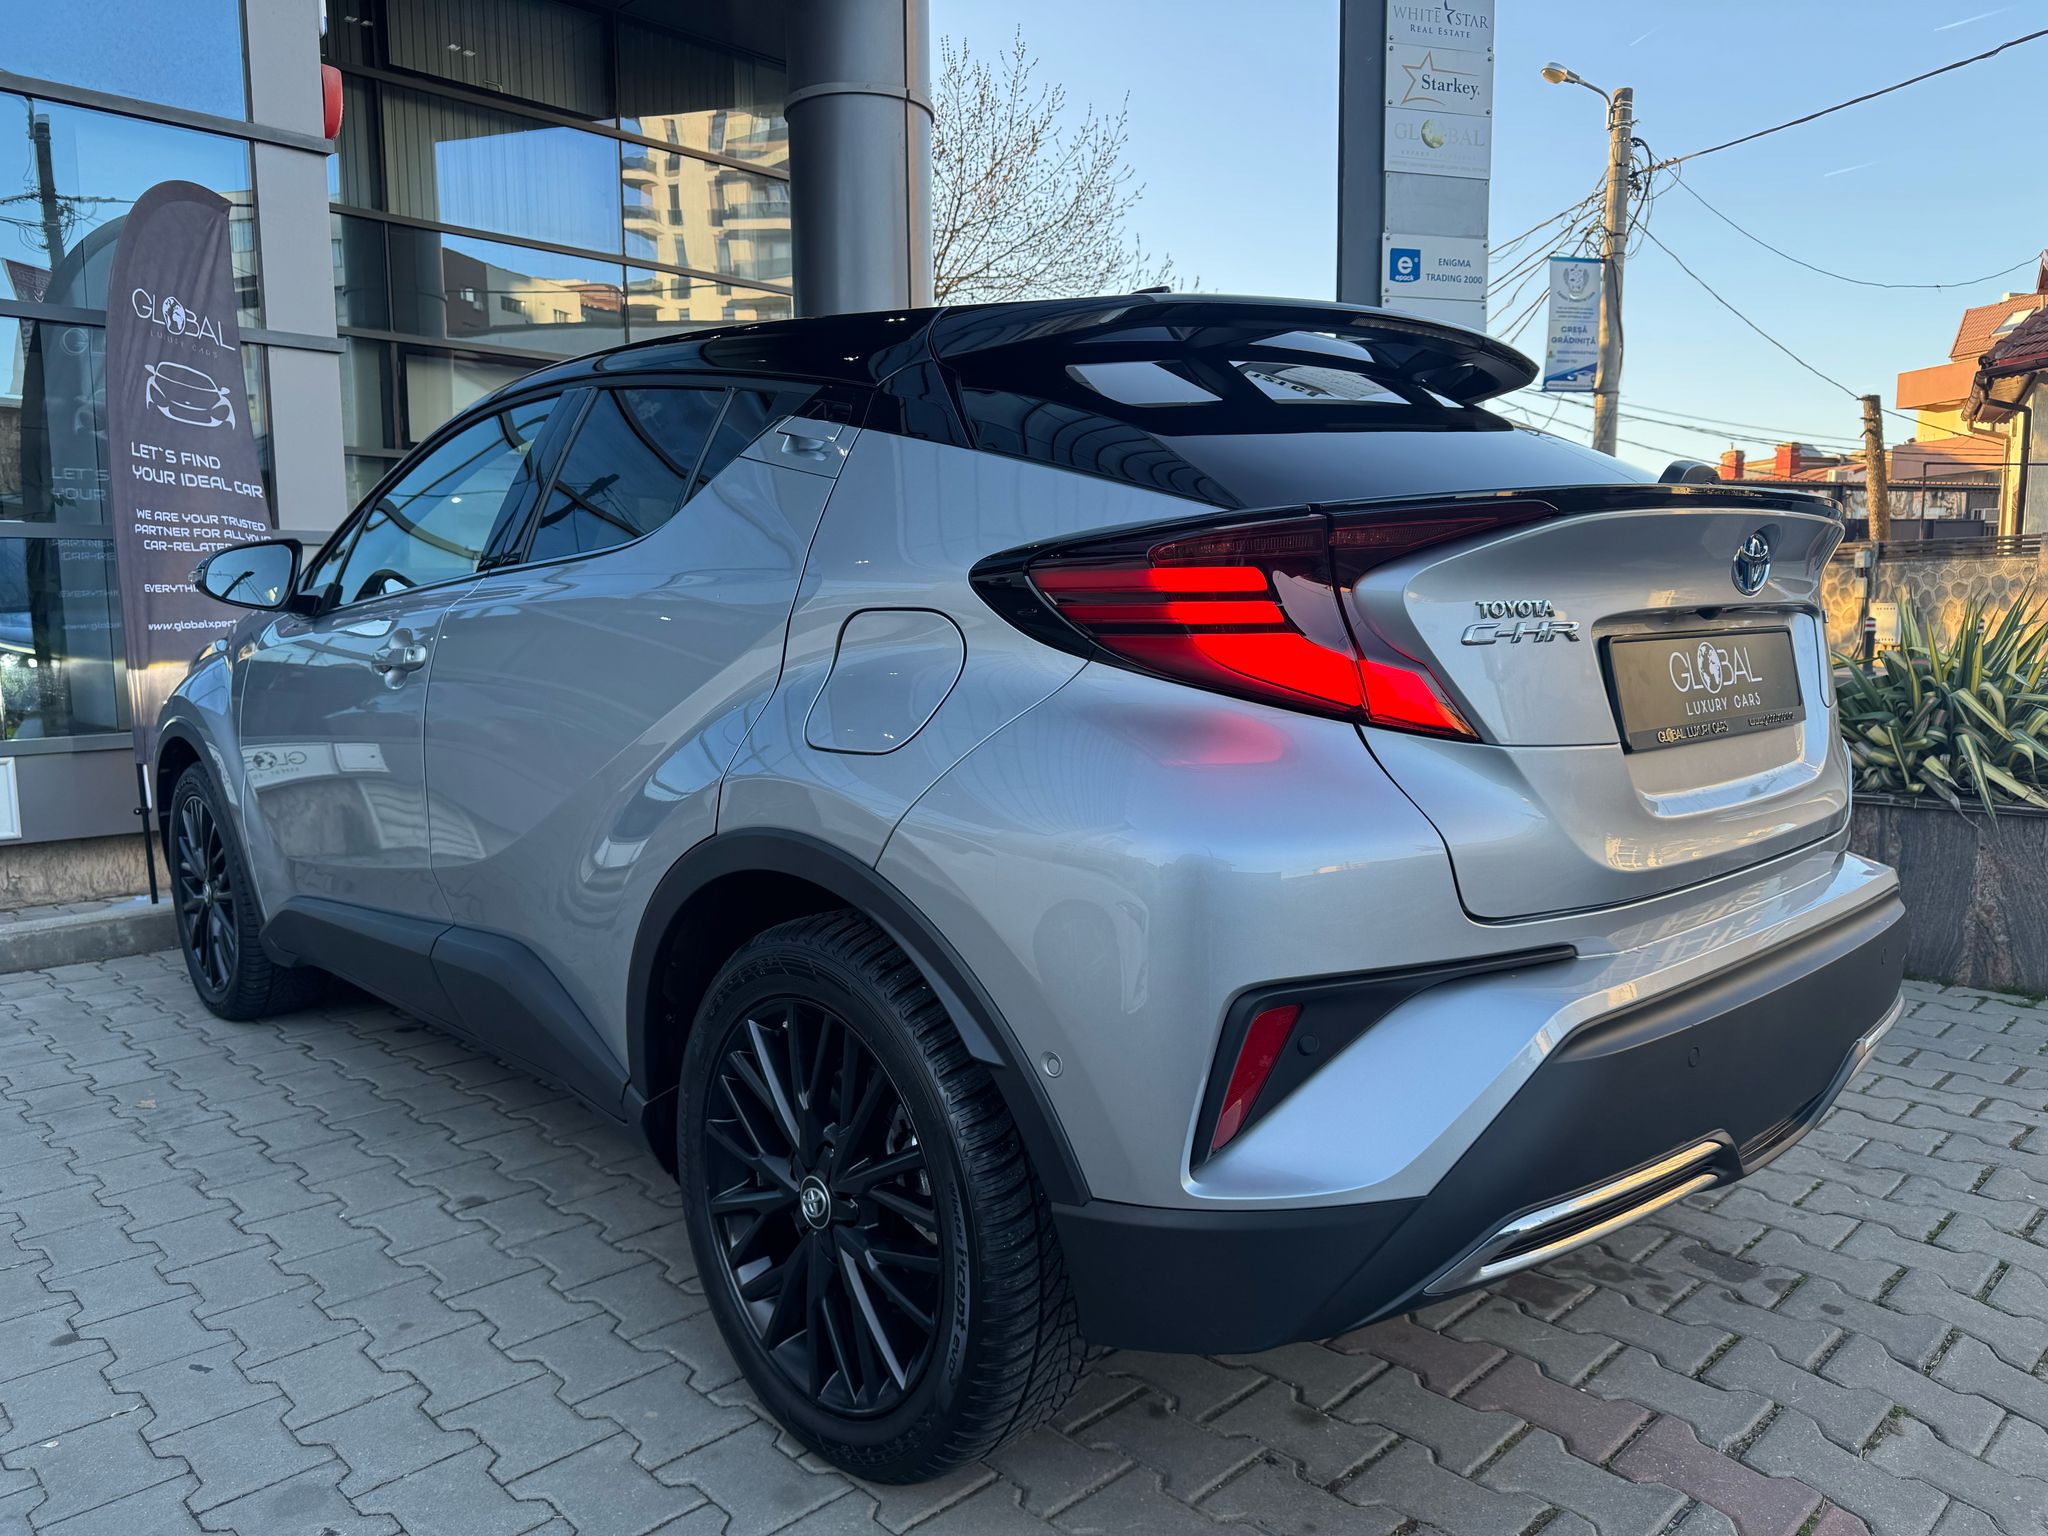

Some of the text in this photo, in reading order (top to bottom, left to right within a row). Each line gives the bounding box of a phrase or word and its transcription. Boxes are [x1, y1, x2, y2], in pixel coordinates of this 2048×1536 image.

[1393, 5, 1489, 29] WHITE STAR
[1438, 258, 1471, 268] ENIGMA
[1426, 273, 1483, 284] TRADING 2000
[132, 288, 236, 351] GLOBAL
[180, 452, 221, 470] FIND
[132, 464, 263, 498] YOUR IDEAL CAR
[134, 523, 190, 538] PARTNER
[193, 528, 221, 539] FOR
[223, 529, 245, 541] ALL
[136, 508, 266, 532] WE ARE YOUR TRUSTED
[1475, 599, 1556, 619] TOYOTA
[1460, 621, 1581, 646] C-HR
[1669, 641, 1763, 694] GLOBAL
[1686, 692, 1761, 716] LUXURY CARS
[1657, 727, 1687, 744] GLOBAL
